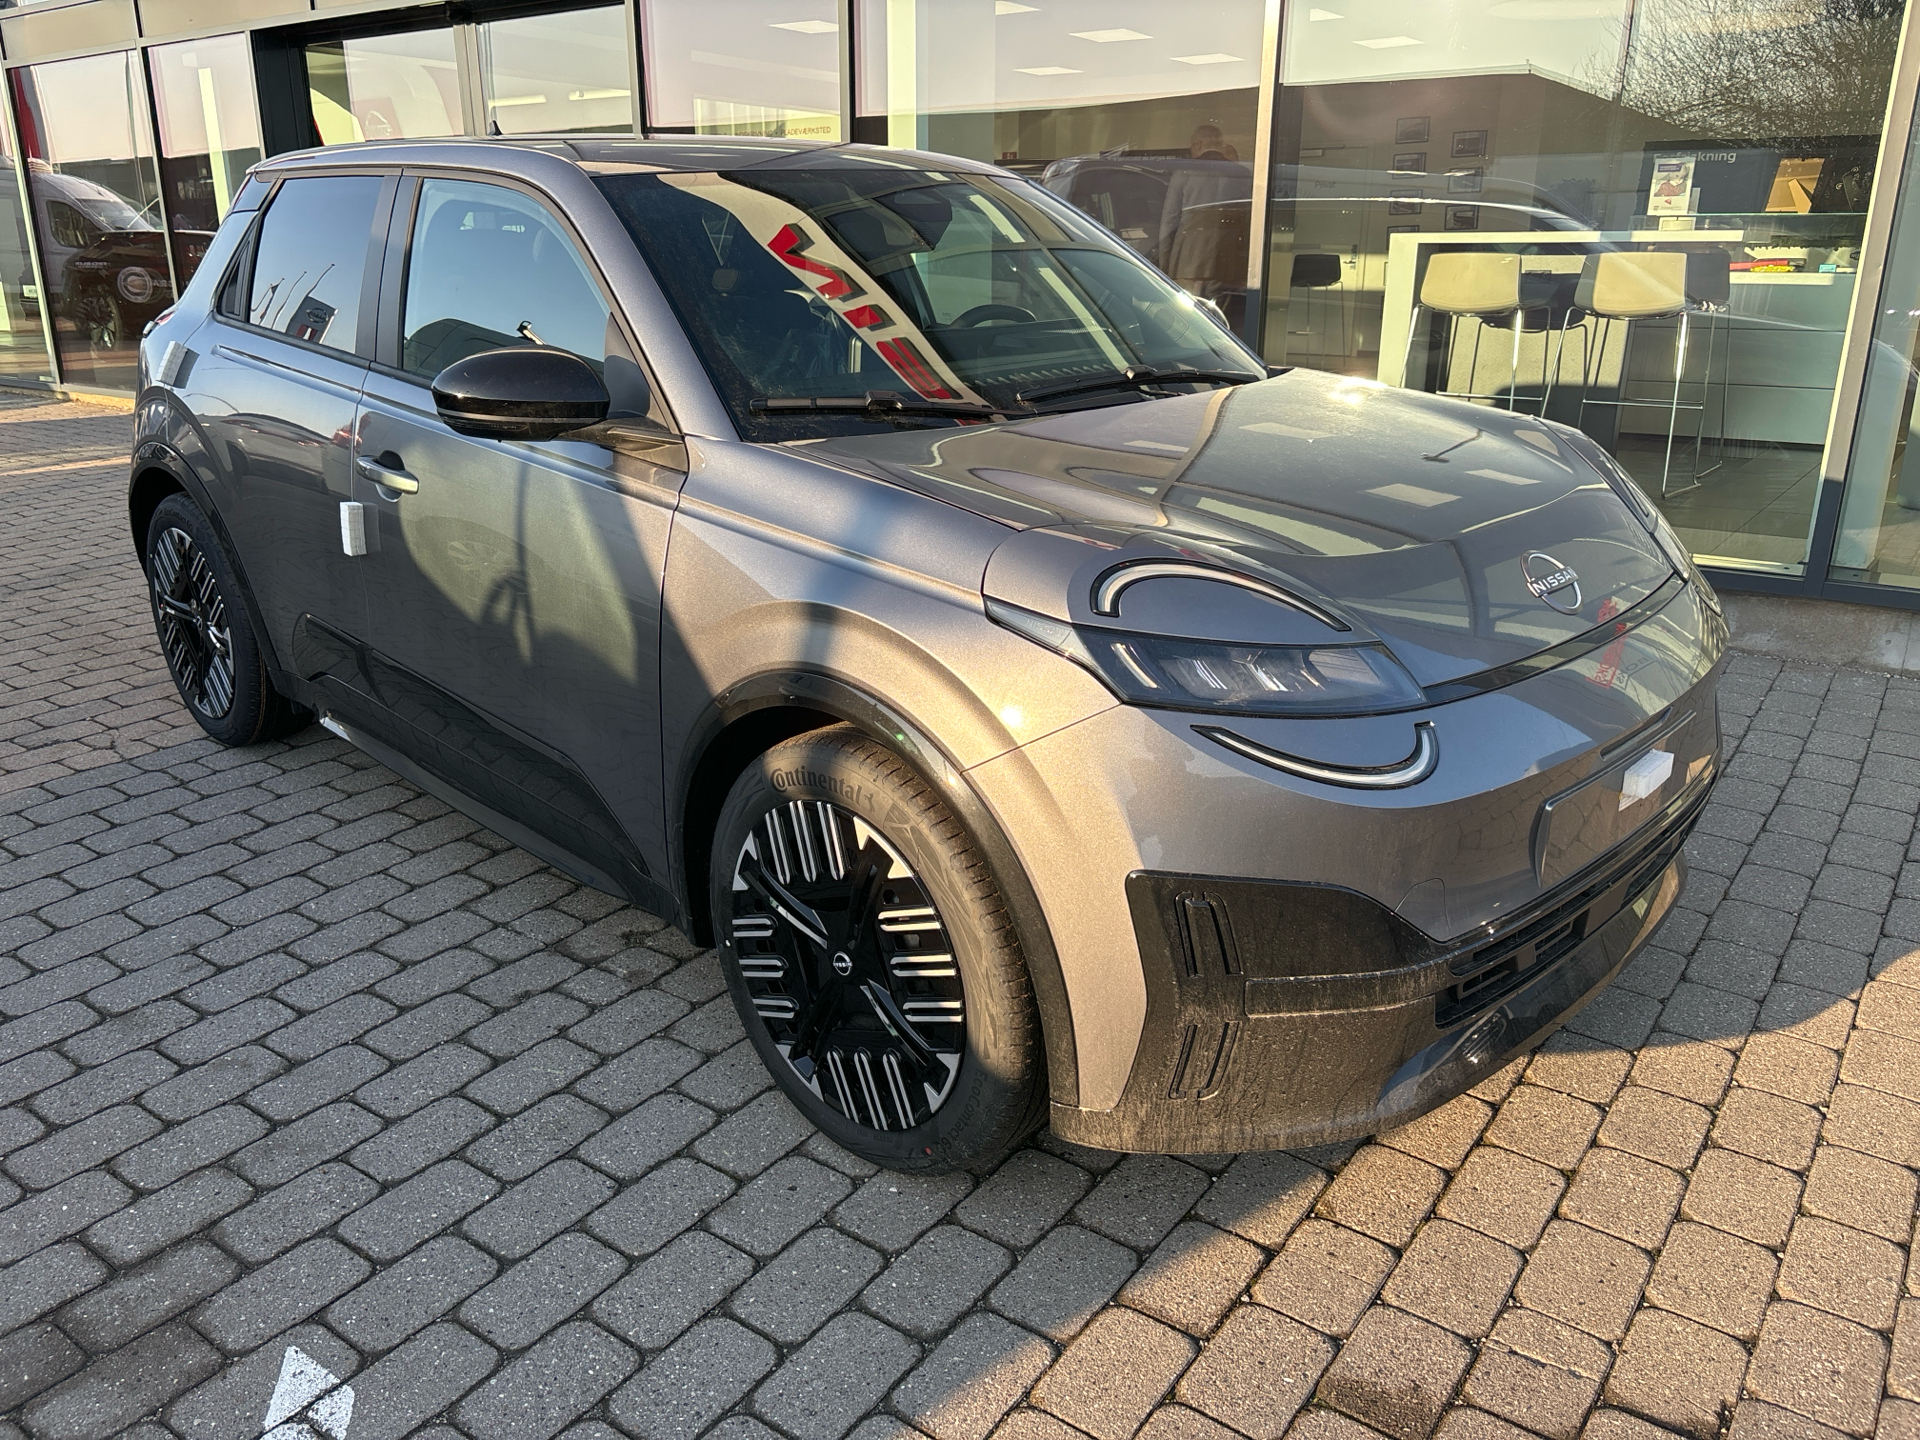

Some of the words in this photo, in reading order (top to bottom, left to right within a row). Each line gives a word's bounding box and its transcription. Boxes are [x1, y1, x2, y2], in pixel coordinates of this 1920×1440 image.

[780, 126, 832, 137] PLADEVÆRKSTED
[1314, 181, 1336, 190] Privat
[1532, 569, 1577, 593] NISSAN
[770, 765, 863, 806] Continental
[947, 1068, 988, 1142] EcoContact
